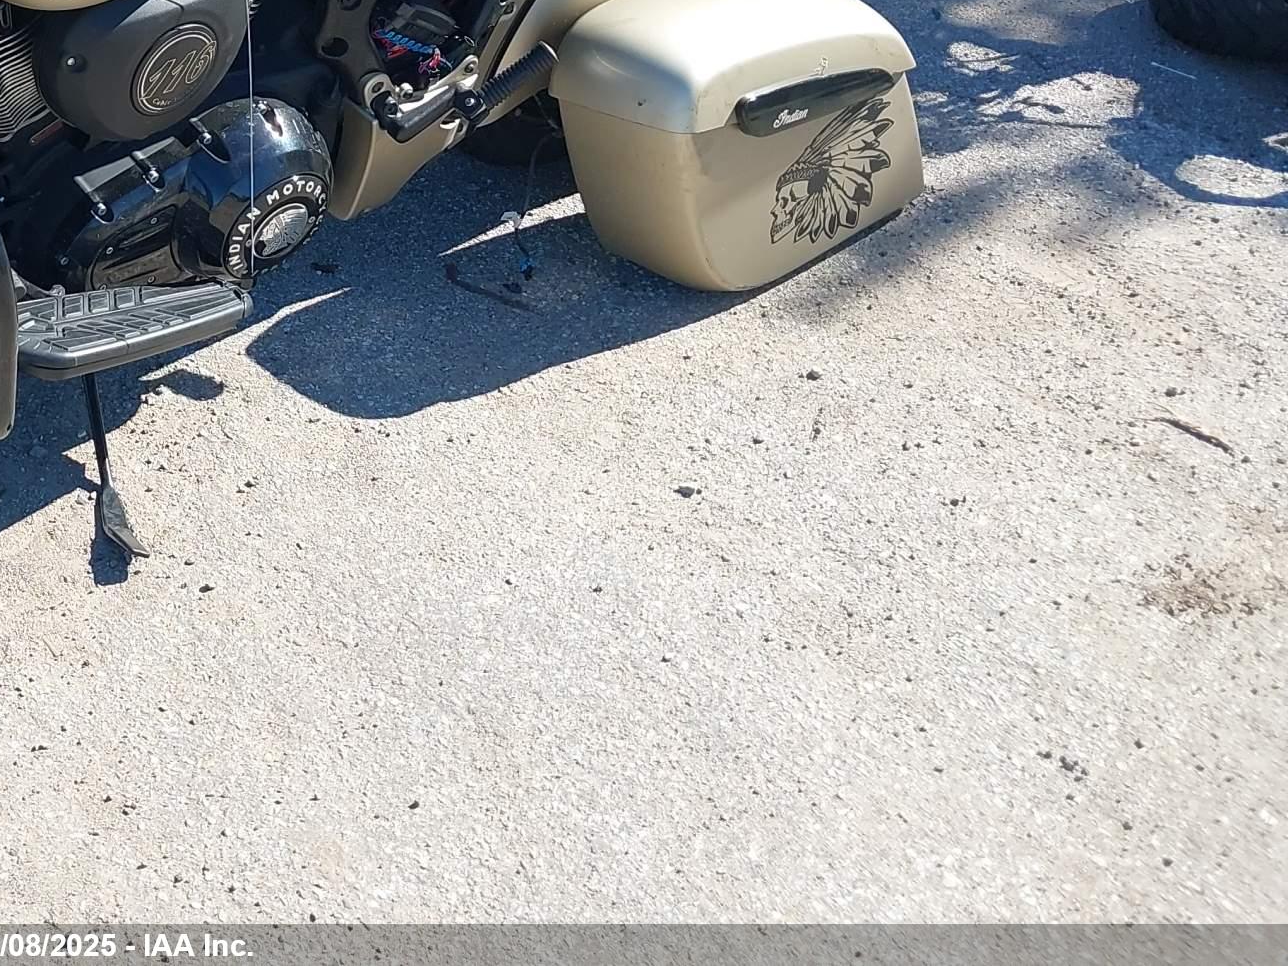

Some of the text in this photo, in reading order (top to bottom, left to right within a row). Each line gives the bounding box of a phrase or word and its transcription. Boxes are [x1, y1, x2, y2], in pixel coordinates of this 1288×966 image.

[141, 41, 216, 99] 116
[773, 108, 809, 128] Indian
[228, 207, 261, 270] INDIAN
